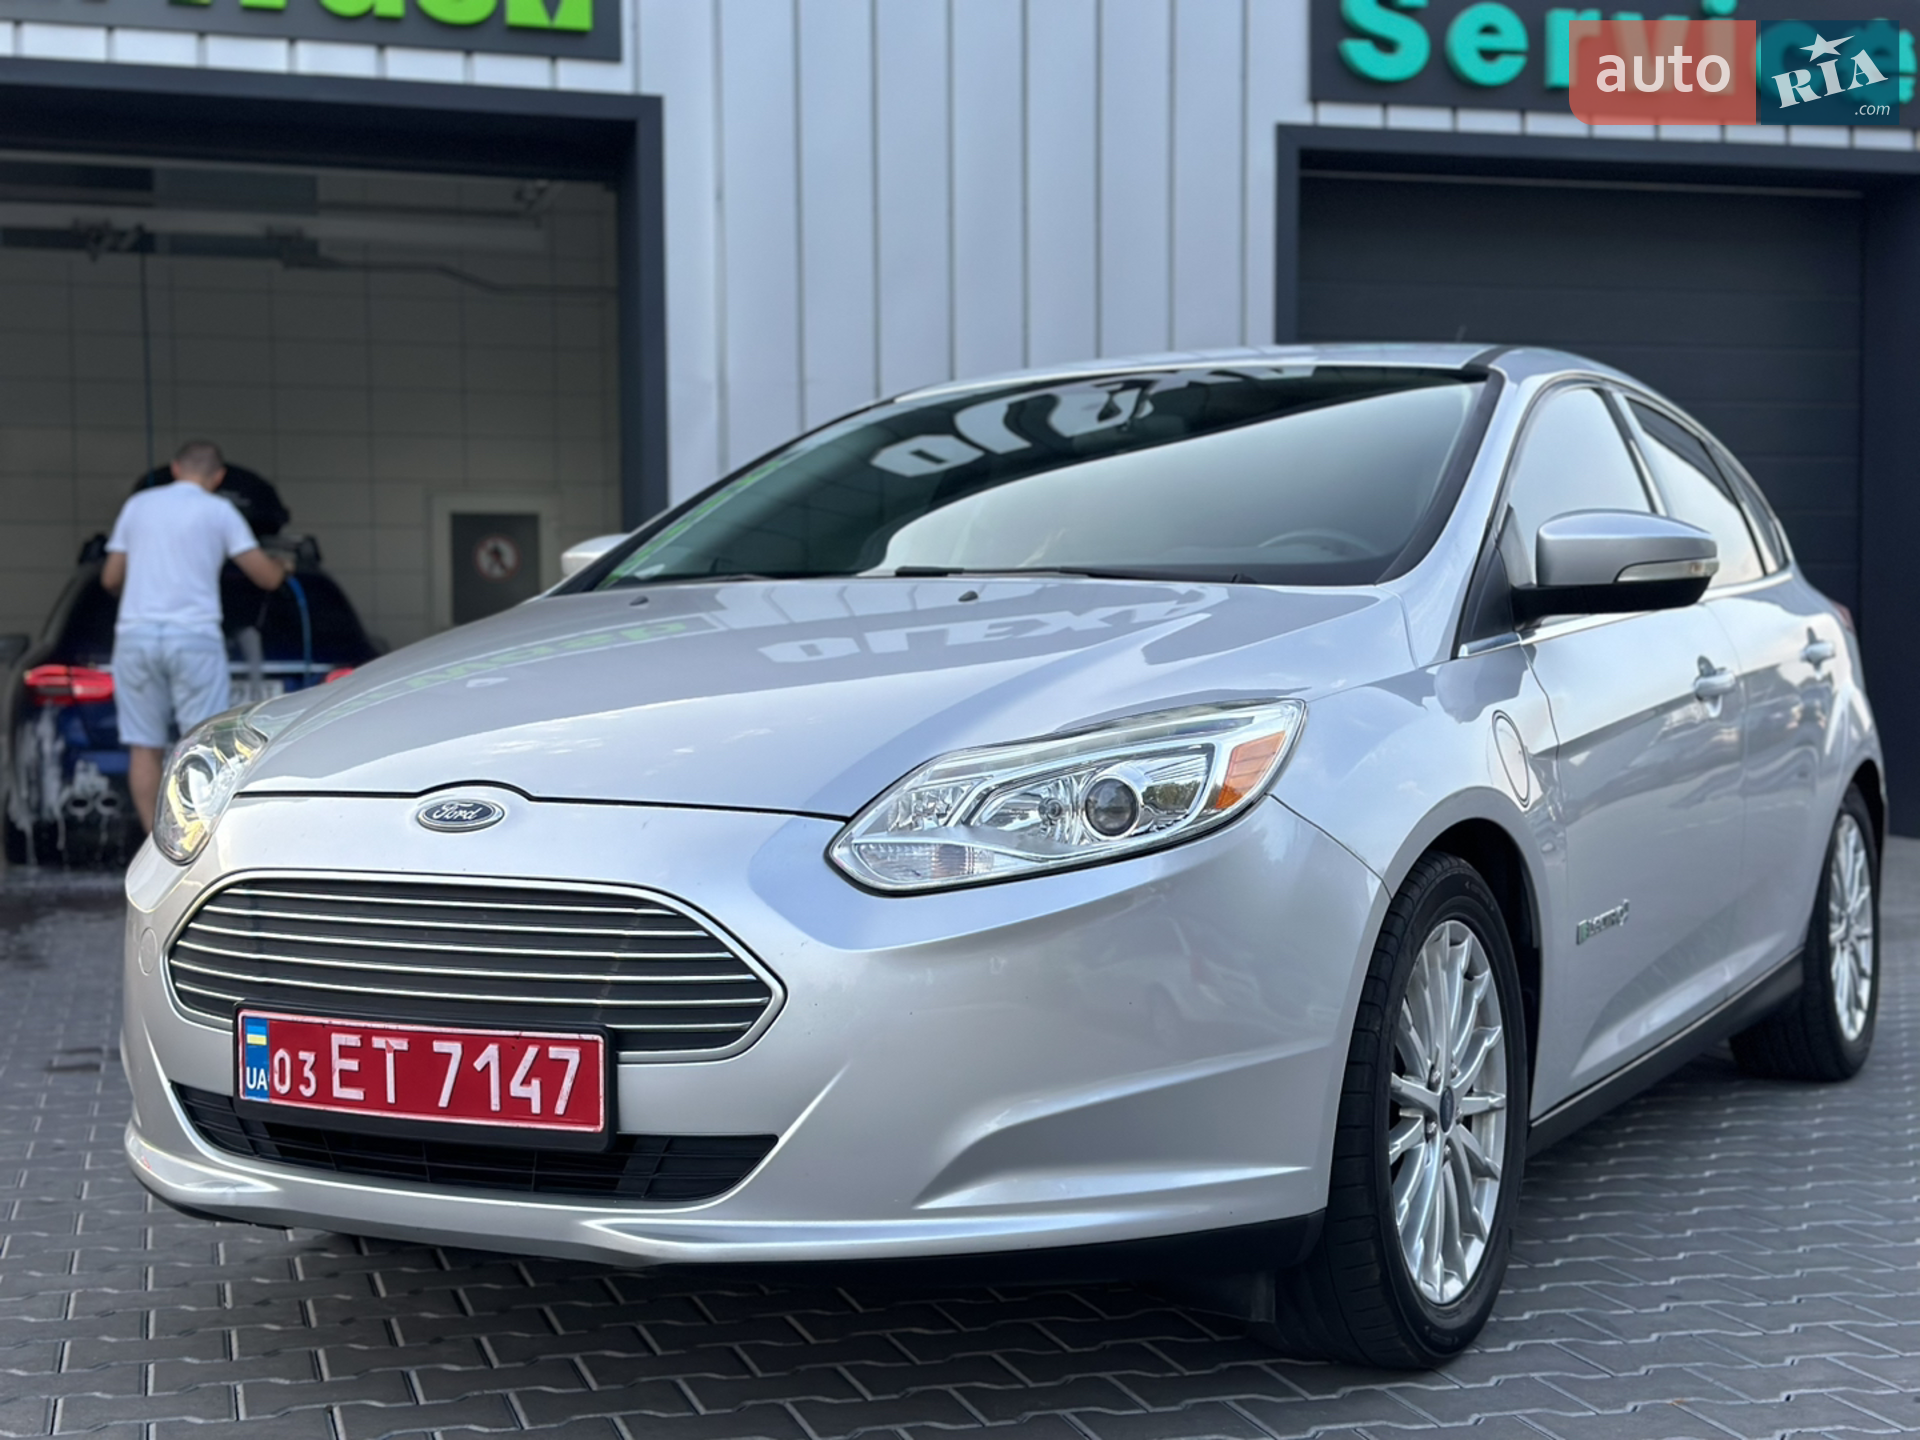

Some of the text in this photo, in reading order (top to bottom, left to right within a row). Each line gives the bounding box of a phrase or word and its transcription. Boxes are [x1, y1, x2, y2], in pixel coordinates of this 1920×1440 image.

[432, 801, 483, 820] Ford
[246, 1067, 268, 1091] UA
[273, 1032, 581, 1115] 03 ET 7147
